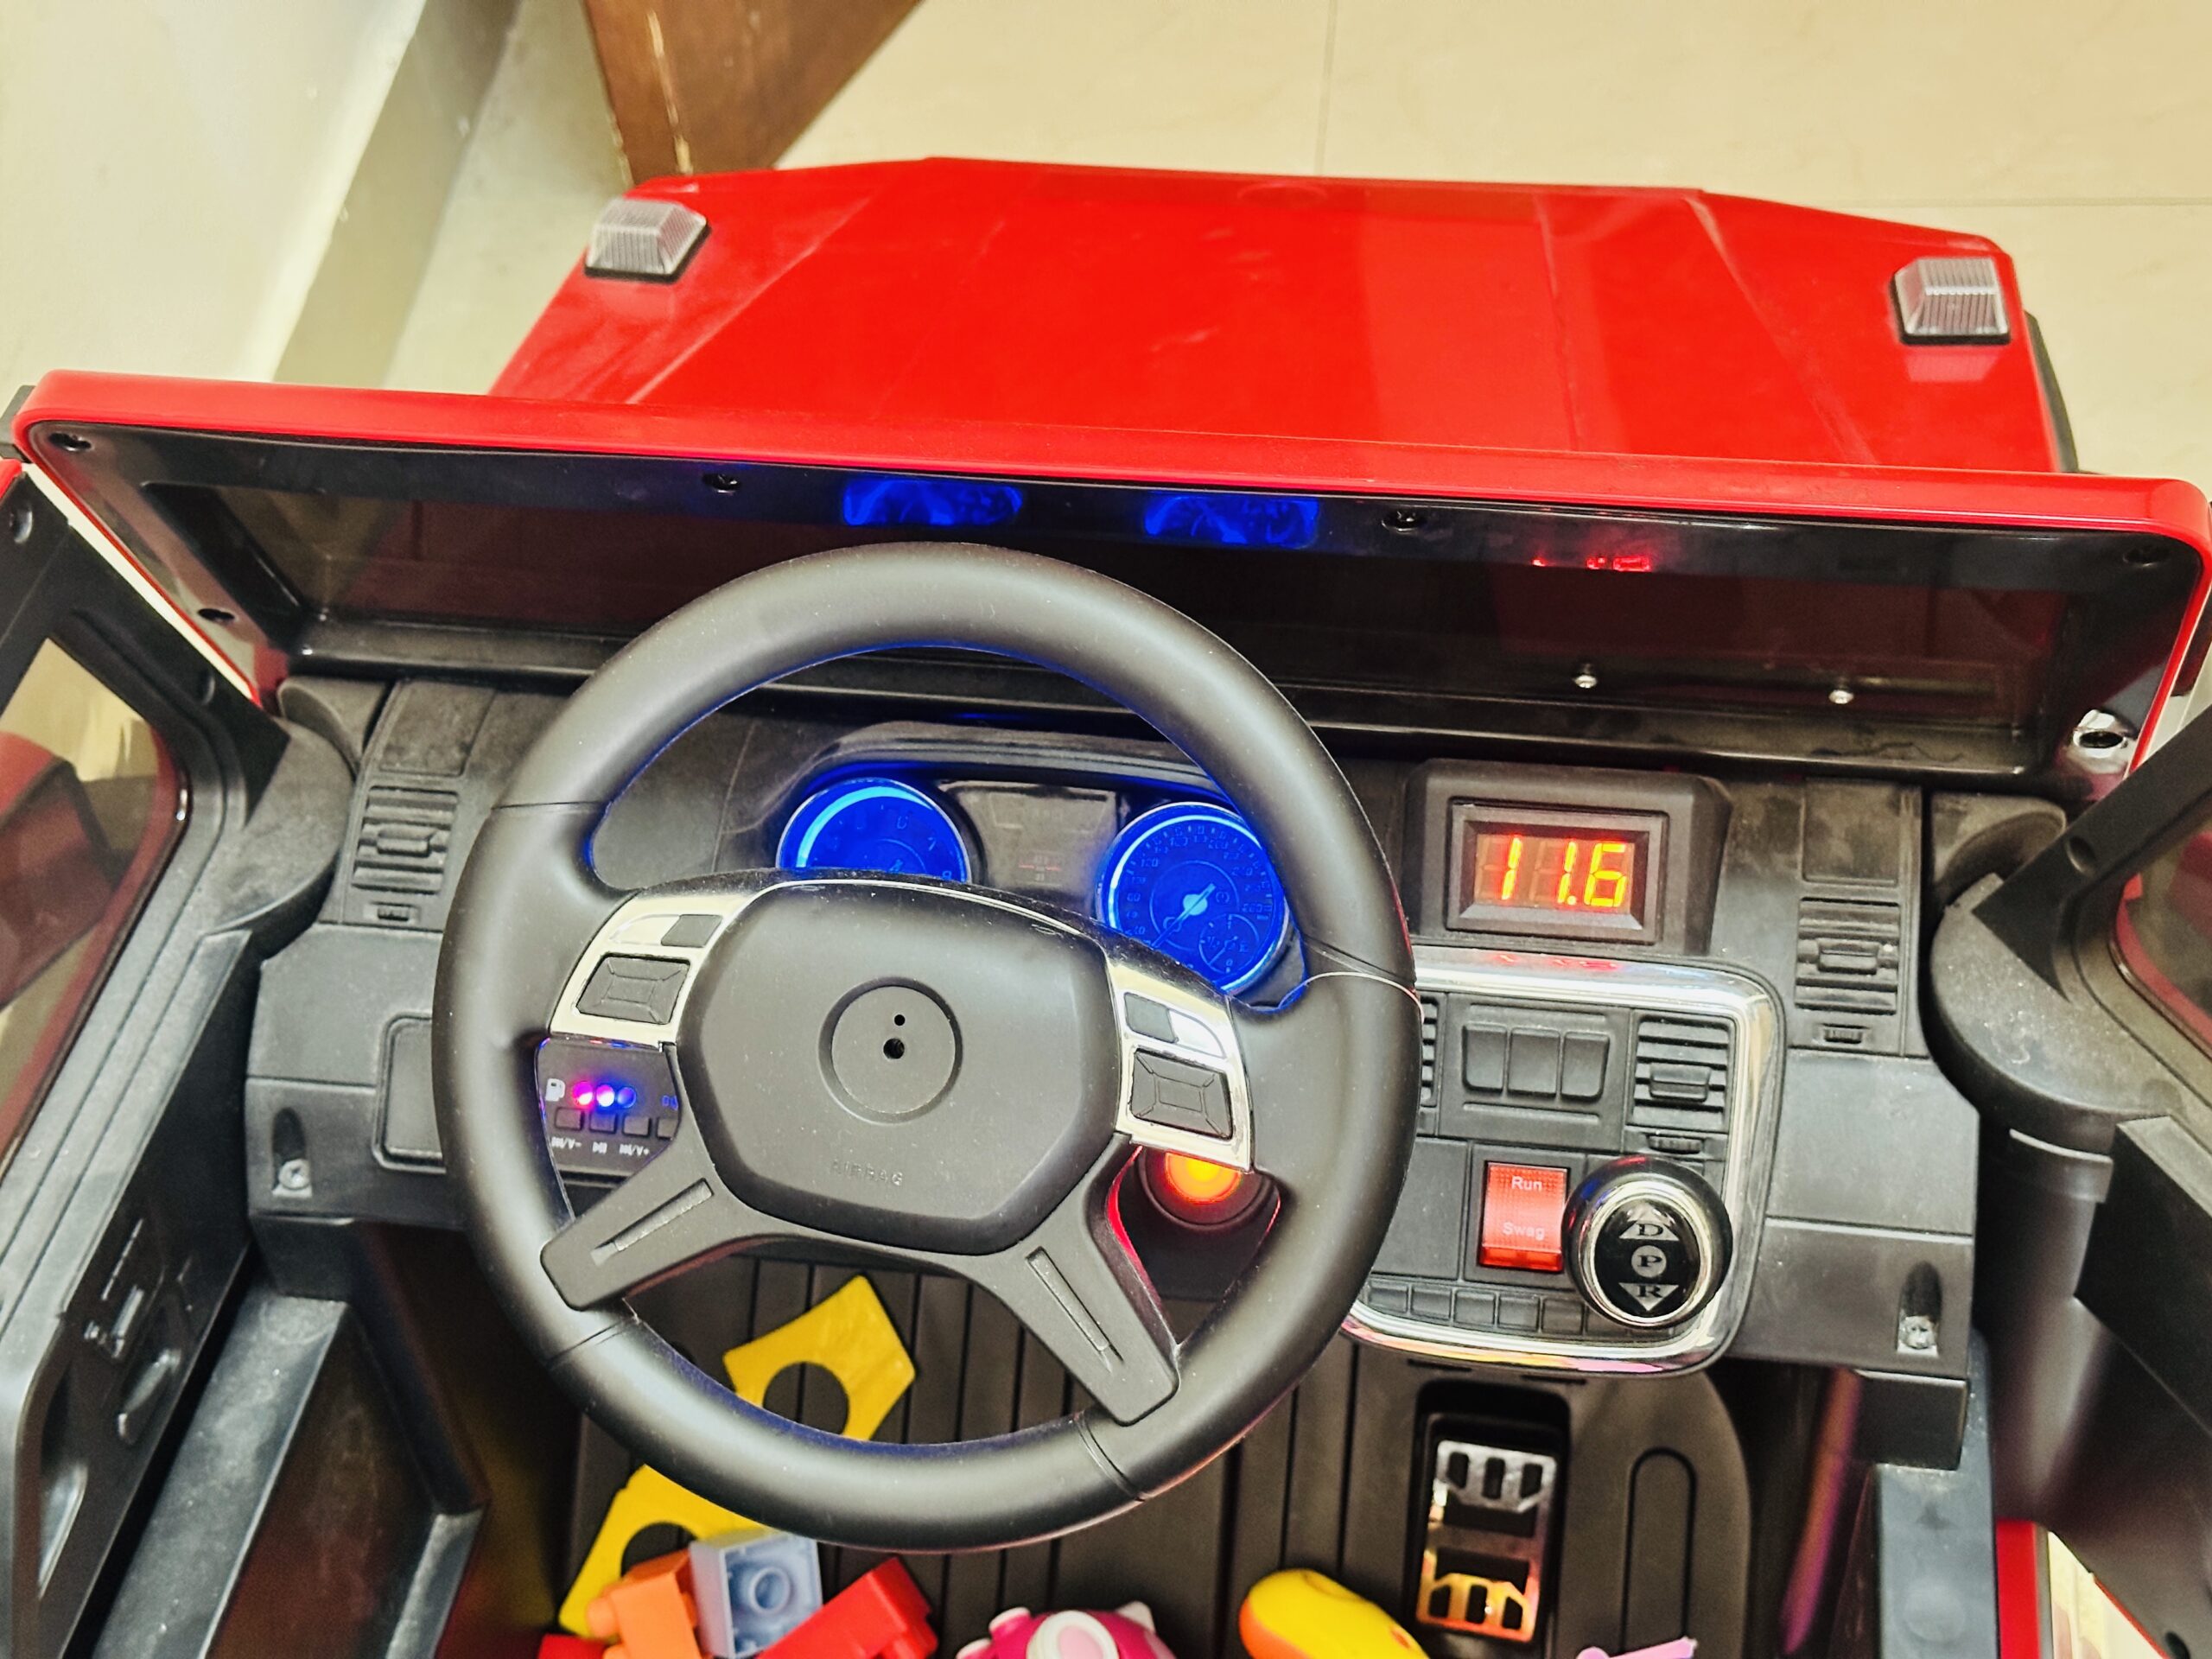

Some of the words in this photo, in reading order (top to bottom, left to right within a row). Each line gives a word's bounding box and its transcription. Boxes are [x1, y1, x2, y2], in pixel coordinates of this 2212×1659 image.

[1501, 837, 1627, 908] 11.6
[1511, 1175, 1543, 1192] Run
[1503, 1220, 1545, 1241] Swag
[1637, 1223, 1664, 1237] D
[1637, 1254, 1663, 1268] P
[1637, 1284, 1662, 1298] R
